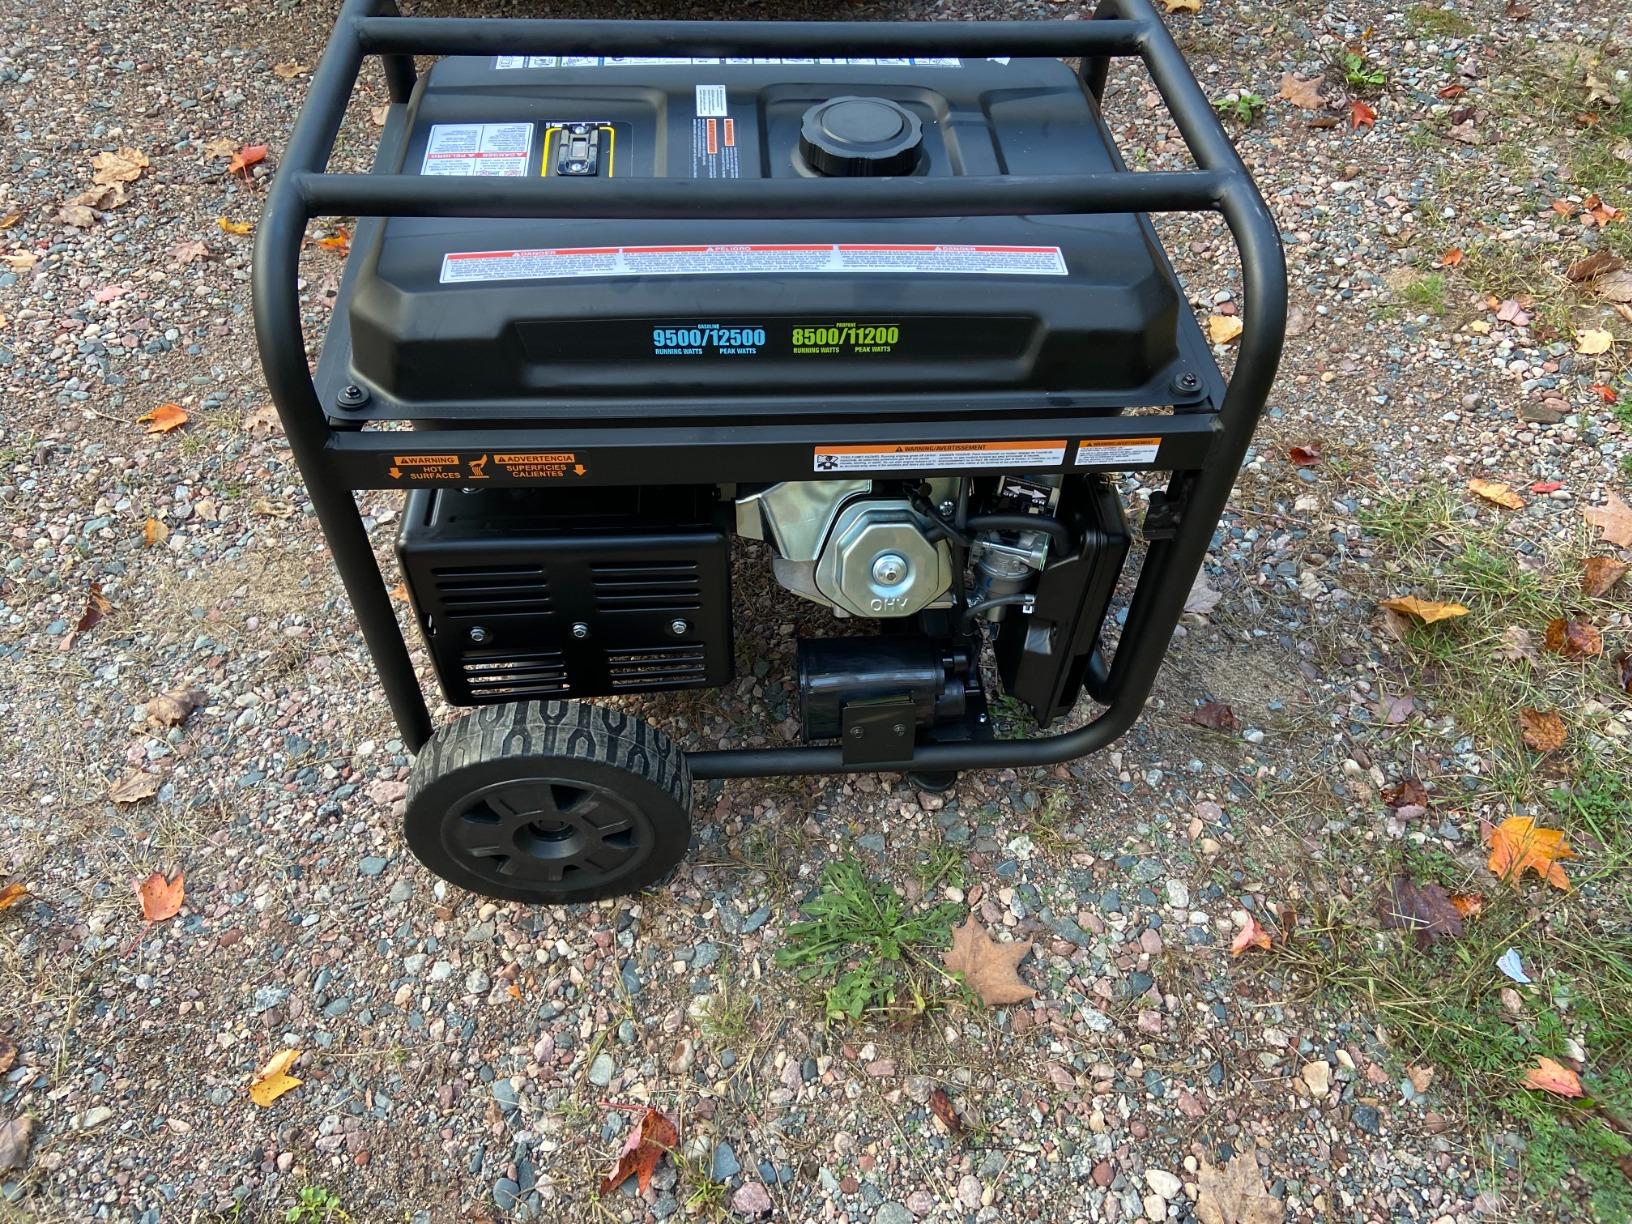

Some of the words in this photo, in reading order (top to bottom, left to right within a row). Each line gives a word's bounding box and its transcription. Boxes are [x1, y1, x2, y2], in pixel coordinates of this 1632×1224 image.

[653, 329, 766, 347] 9500/12500
[792, 327, 899, 346] 8500/11200
[793, 346, 820, 354] RUNNING
[871, 345, 891, 353] WATTS
[408, 456, 455, 464] WARNING
[507, 455, 573, 463] ADVERTENCIA
[506, 464, 567, 472] SUPERFICIES
[410, 472, 461, 480] SURFACES
[512, 470, 564, 478] CALIENTES
[870, 598, 909, 612] OHV
